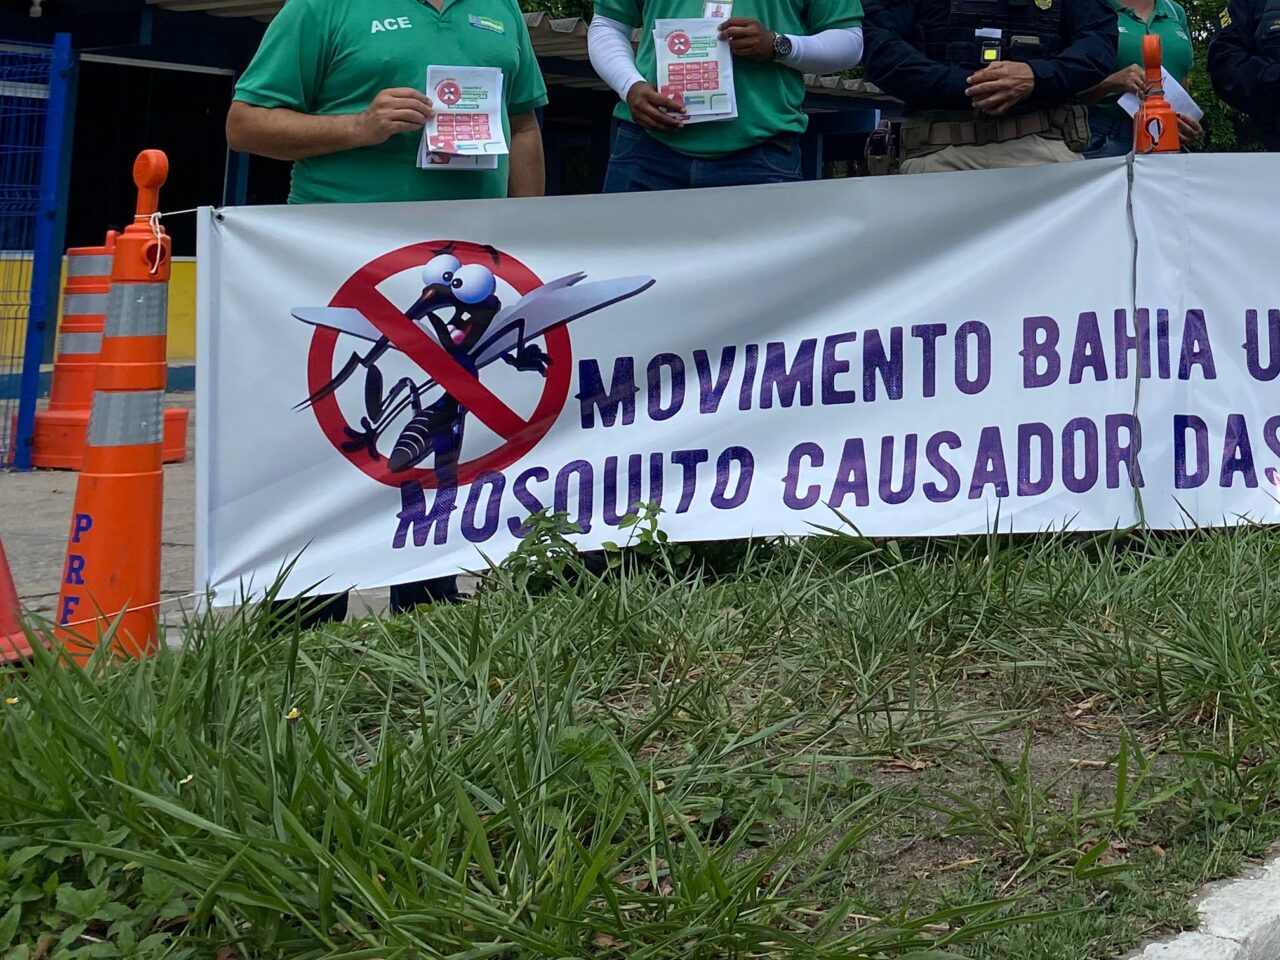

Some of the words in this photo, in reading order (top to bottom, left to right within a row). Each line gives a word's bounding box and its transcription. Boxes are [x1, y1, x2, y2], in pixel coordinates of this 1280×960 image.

[370, 16, 412, 34] ACE
[575, 320, 991, 429] MOVIMENTO
[1018, 308, 1217, 388] BAHIA
[392, 446, 755, 549] MOSQUITO
[781, 413, 1146, 511] CAUSADOR
